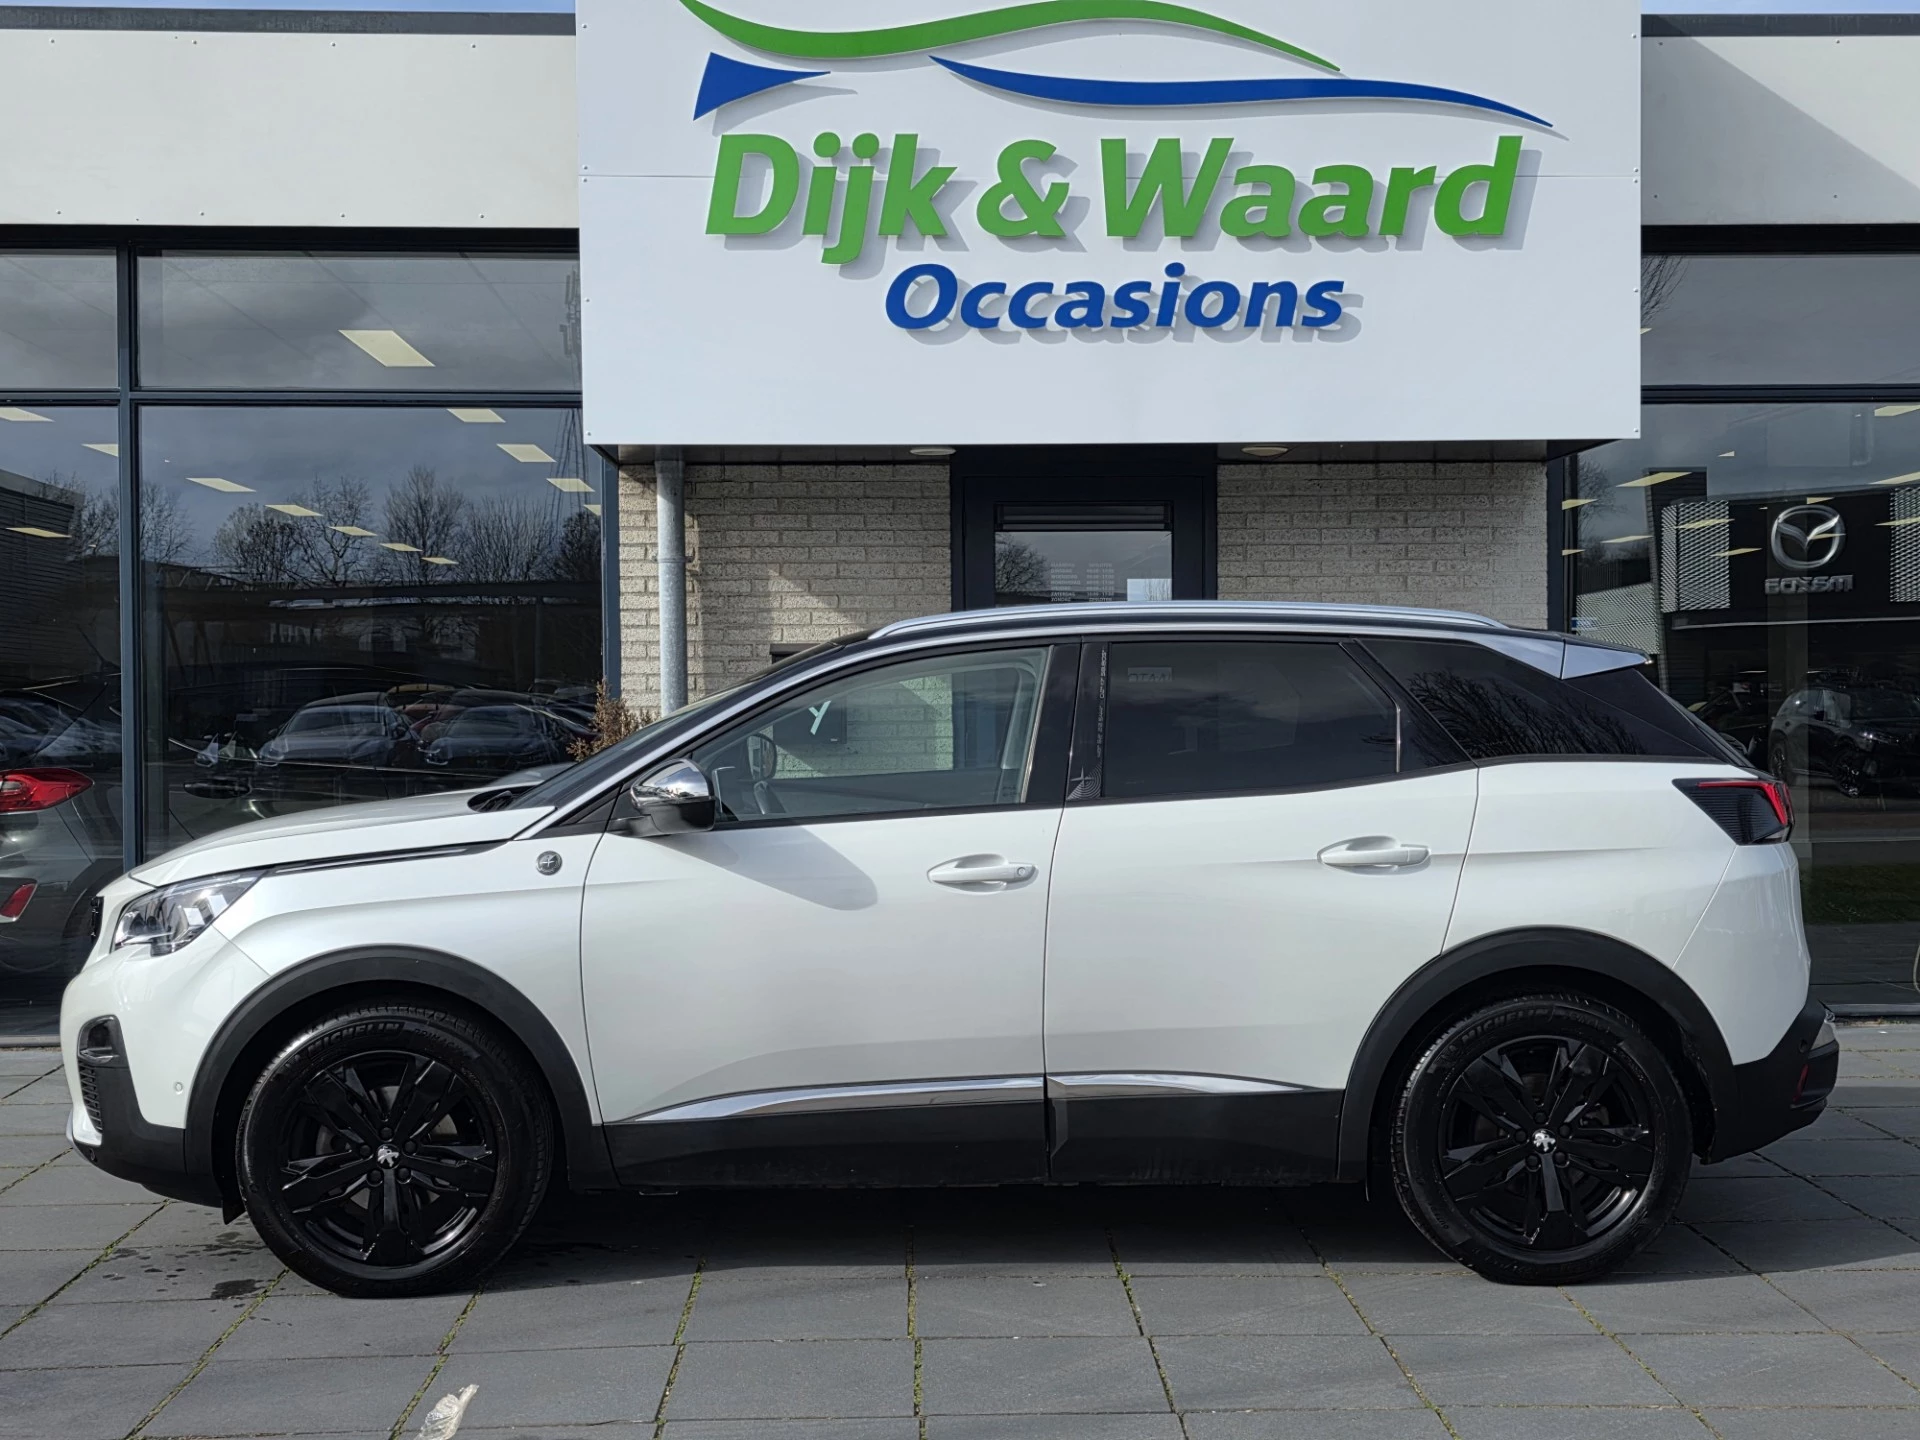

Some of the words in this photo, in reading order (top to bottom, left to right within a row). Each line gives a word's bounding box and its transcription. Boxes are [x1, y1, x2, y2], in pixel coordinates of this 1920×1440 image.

[706, 131, 955, 264] Dijk
[977, 139, 1070, 240] &
[1099, 135, 1523, 240] Waard
[885, 262, 1345, 330] Occasions
[307, 1021, 402, 1053] MICHELIN
[1461, 1007, 1549, 1042] MICHELIN
